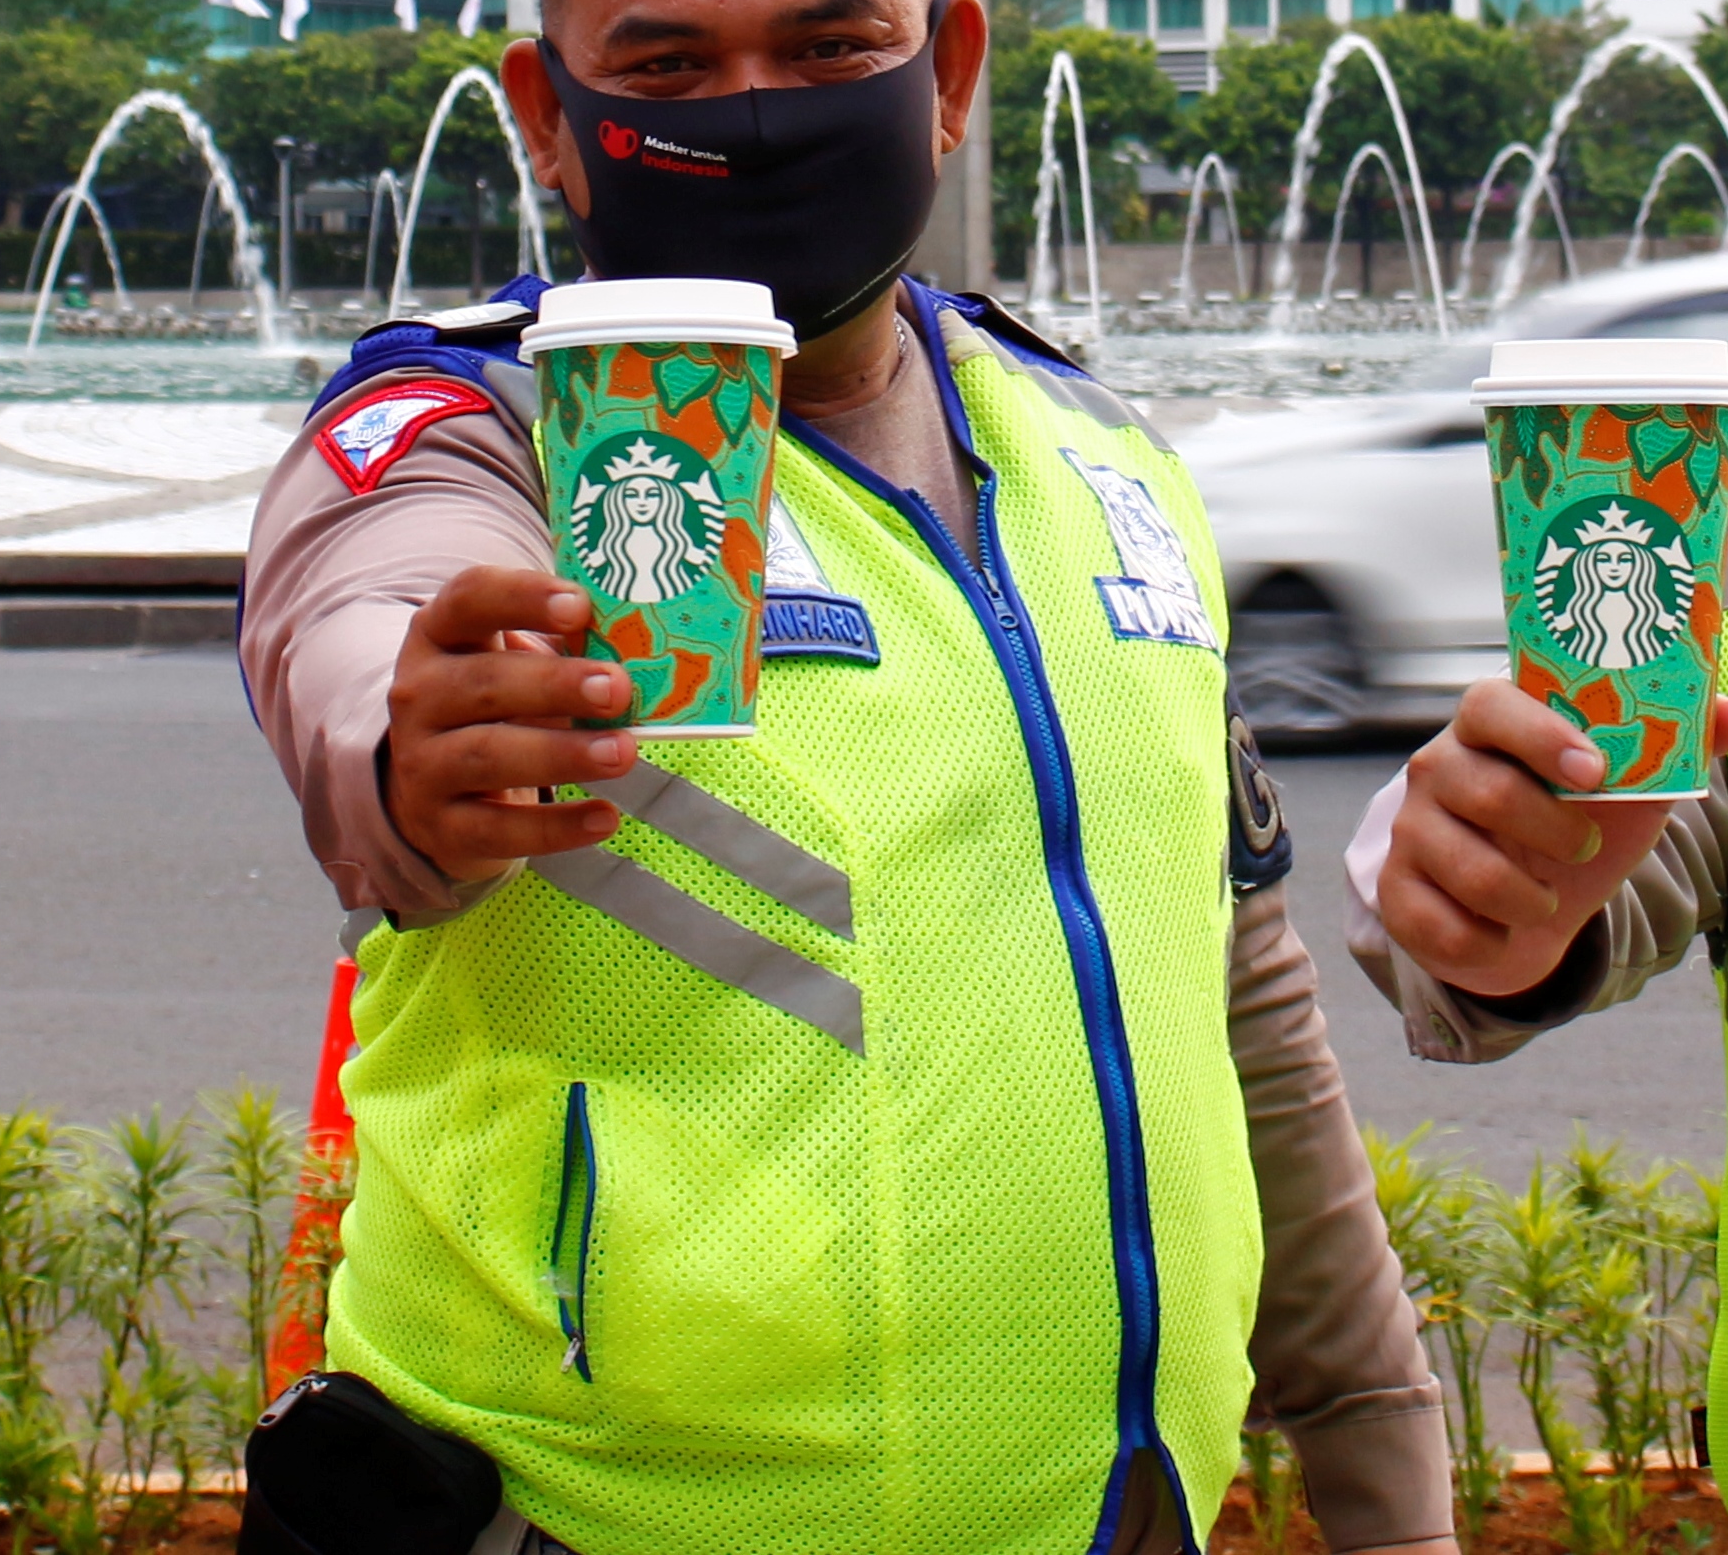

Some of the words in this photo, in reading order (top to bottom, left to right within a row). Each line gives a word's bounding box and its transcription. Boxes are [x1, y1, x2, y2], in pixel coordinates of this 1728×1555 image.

[644, 135, 689, 156] Masker
[691, 149, 728, 162] untuk
[641, 151, 730, 177] Indonesia
[762, 603, 865, 646] INHARD
